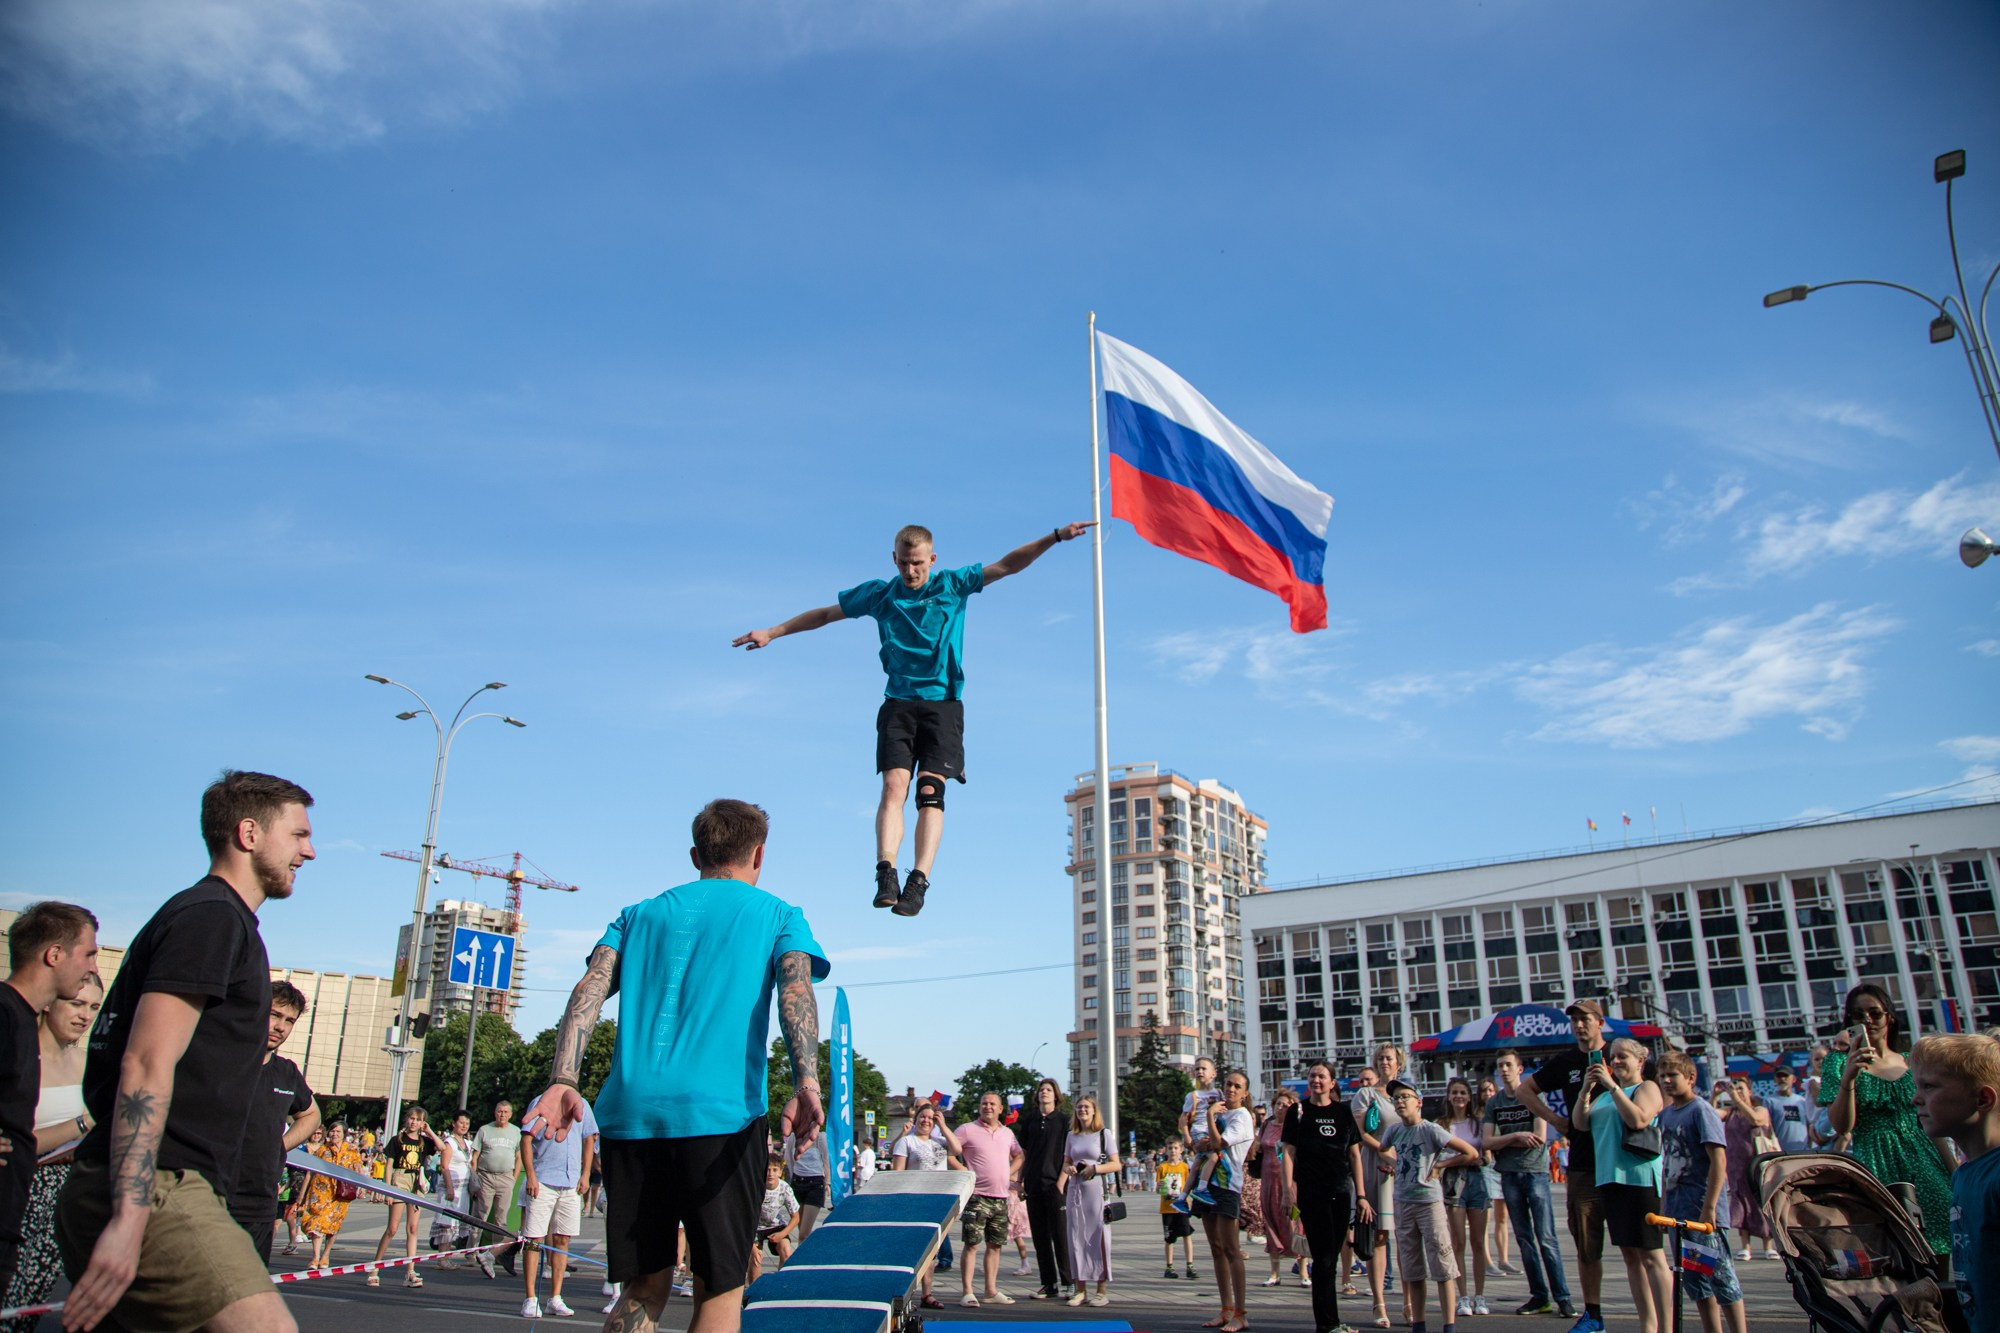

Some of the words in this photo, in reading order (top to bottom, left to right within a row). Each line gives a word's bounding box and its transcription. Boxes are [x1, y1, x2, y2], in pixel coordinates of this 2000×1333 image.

[1495, 1016, 1515, 1039] 12
[1515, 1013, 1552, 1027] ДЕНЬ
[1514, 1022, 1573, 1038] РОССИИ
[1496, 1109, 1531, 1121] Kappa
